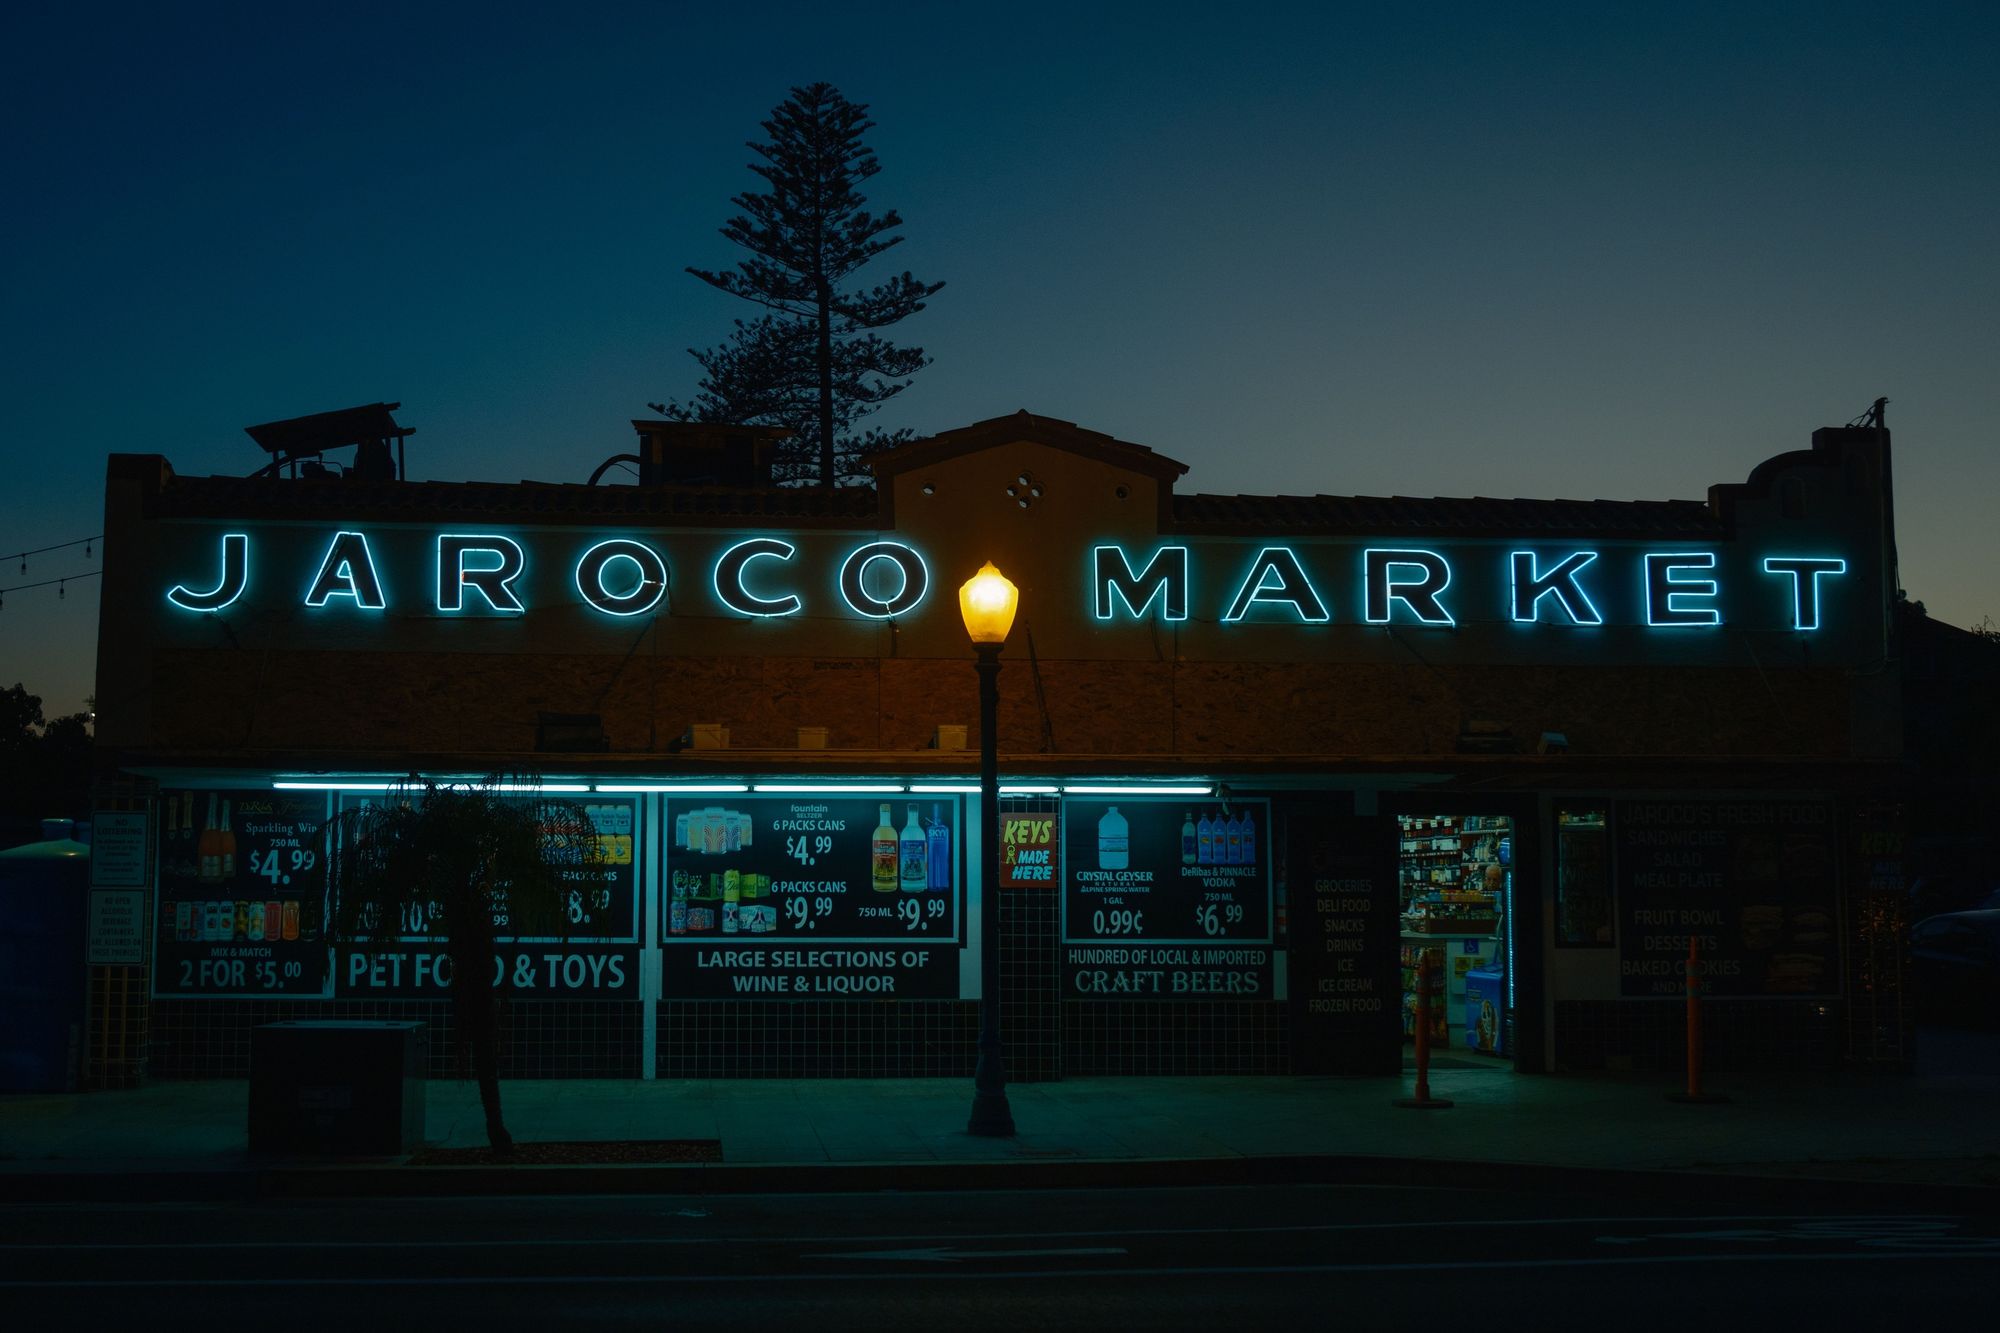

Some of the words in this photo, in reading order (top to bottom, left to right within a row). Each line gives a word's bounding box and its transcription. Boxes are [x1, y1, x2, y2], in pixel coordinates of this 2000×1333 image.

[166, 530, 929, 619] JAROCO
[1093, 545, 1847, 631] MARKET
[246, 822, 293, 836] Sparkling
[298, 822, 318, 834] Win
[773, 820, 781, 831] 6
[782, 820, 816, 831] PACKS
[817, 820, 846, 831] CANS
[1003, 820, 1053, 845] KEYS
[270, 838, 287, 848] 750
[288, 838, 301, 848] ML
[1628, 831, 1727, 848] SANDWICHES
[786, 835, 832, 866] $4.99
[1018, 850, 1050, 865] MADE
[1653, 851, 1703, 867] SALAD
[249, 849, 316, 886] $4.99
[1011, 865, 1054, 881] HERE
[1181, 867, 1211, 877] DeRibas
[1212, 867, 1219, 877] &
[1219, 867, 1257, 877] PINNACLE
[1076, 871, 1115, 882] CRYSTAL
[1115, 871, 1154, 882] GEYSER
[1202, 878, 1236, 888] VODKA
[1632, 872, 1677, 889] MEAL
[1679, 872, 1724, 889] PLATE
[771, 881, 779, 893] 6
[780, 881, 816, 893] PACKS
[817, 881, 847, 893] CANS
[1314, 879, 1373, 893] GROCERIES
[1108, 897, 1124, 905] GAL
[1204, 892, 1220, 902] 750
[1221, 892, 1234, 902] ML
[785, 896, 833, 930] $9.99
[858, 906, 877, 918] 750
[878, 906, 893, 918] ML
[1316, 899, 1340, 913] DELI
[1342, 899, 1371, 913] FOOD
[897, 898, 946, 932] $9.99
[1093, 909, 1143, 935] 0.99¢
[1196, 903, 1243, 936] $6.99
[1633, 910, 1678, 926] FRUIT
[1679, 910, 1725, 926] BOWL
[1324, 919, 1366, 932] SNACKS
[1326, 939, 1365, 953] DRINKS
[1643, 935, 1719, 951] DESSETS
[211, 947, 229, 958] MIX
[229, 947, 239, 958] &
[239, 947, 272, 958] MATCH
[697, 950, 766, 968] LARGE
[770, 950, 897, 968] SELECTIONS
[901, 950, 930, 968] OF
[1068, 949, 1129, 965] HUNDRED
[1131, 949, 1148, 965] OF
[1150, 949, 1189, 965] LOCAL
[1191, 949, 1201, 965] &
[1203, 949, 1266, 965] IMPORTED
[350, 954, 407, 988] PET
[512, 953, 537, 988] &
[543, 953, 626, 988] TOYS
[1337, 958, 1355, 972] ICE
[1622, 959, 1672, 976] BAKED
[179, 959, 193, 988] 2
[199, 959, 246, 988] FOR
[255, 960, 302, 989] $5.00
[1075, 970, 1165, 994] CRAFT
[1171, 970, 1260, 994] BEERS
[732, 975, 789, 993] WINE
[793, 975, 809, 993] &
[815, 975, 895, 995] LIQUOR
[1318, 978, 1336, 993] ICE
[1337, 978, 1374, 993] CREAM
[1650, 981, 1677, 993] AND
[1308, 998, 1350, 1013] FROZEN
[1351, 998, 1381, 1013] FOOD
